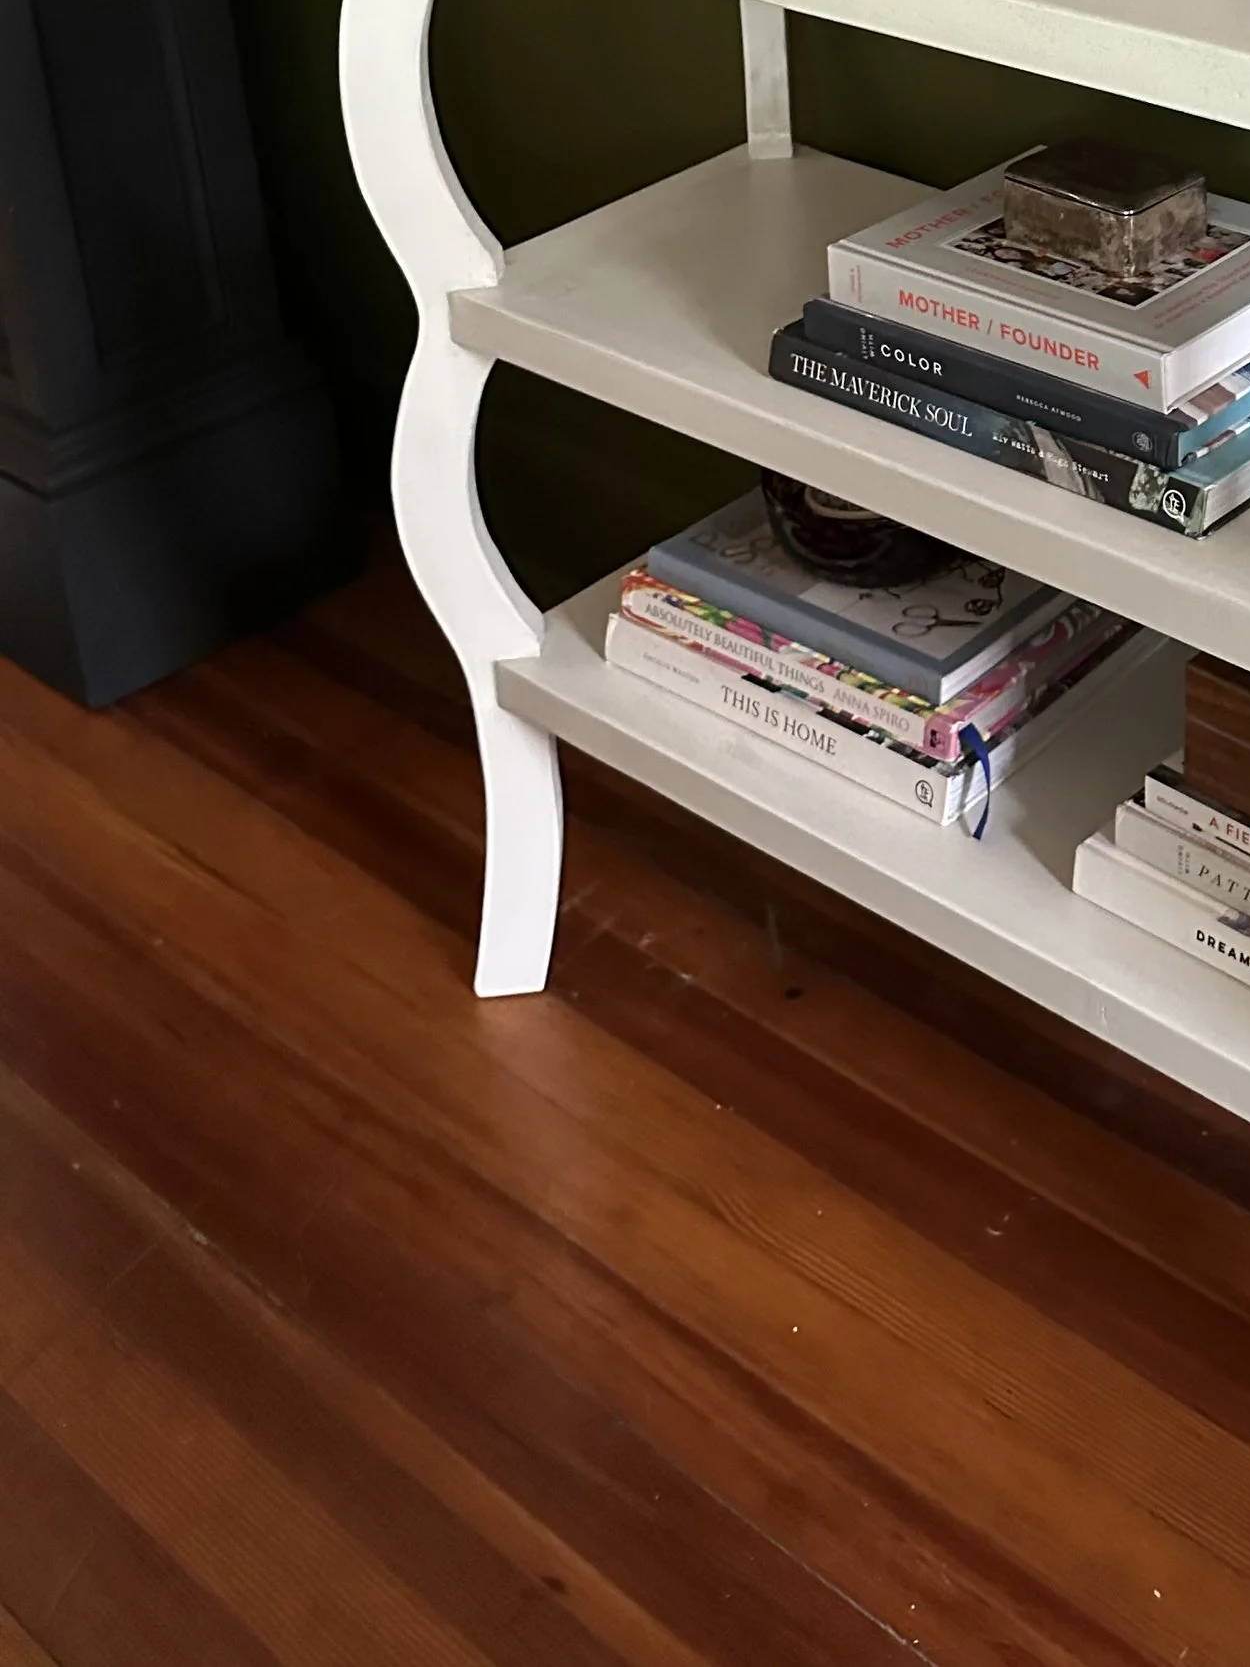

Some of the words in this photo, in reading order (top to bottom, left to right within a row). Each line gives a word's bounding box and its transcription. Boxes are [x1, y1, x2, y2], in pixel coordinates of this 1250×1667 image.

[886, 207, 969, 249] MOTHER
[880, 344, 943, 376] COLOR
[898, 289, 980, 331] MOTHER
[999, 323, 1100, 371] FOUNDER
[790, 353, 827, 383] THE
[830, 368, 922, 419] MAVERICK
[924, 403, 973, 437] SOUL
[645, 604, 713, 641] ABSOLUTELY
[714, 635, 774, 672] BEAUTIFUL
[777, 661, 826, 694] THINGS
[833, 688, 870, 715] ANNA
[873, 705, 910, 733] SPIRO
[721, 685, 760, 719] THIS
[764, 706, 779, 728] IS
[783, 716, 837, 756] HOME
[1209, 817, 1220, 830] A
